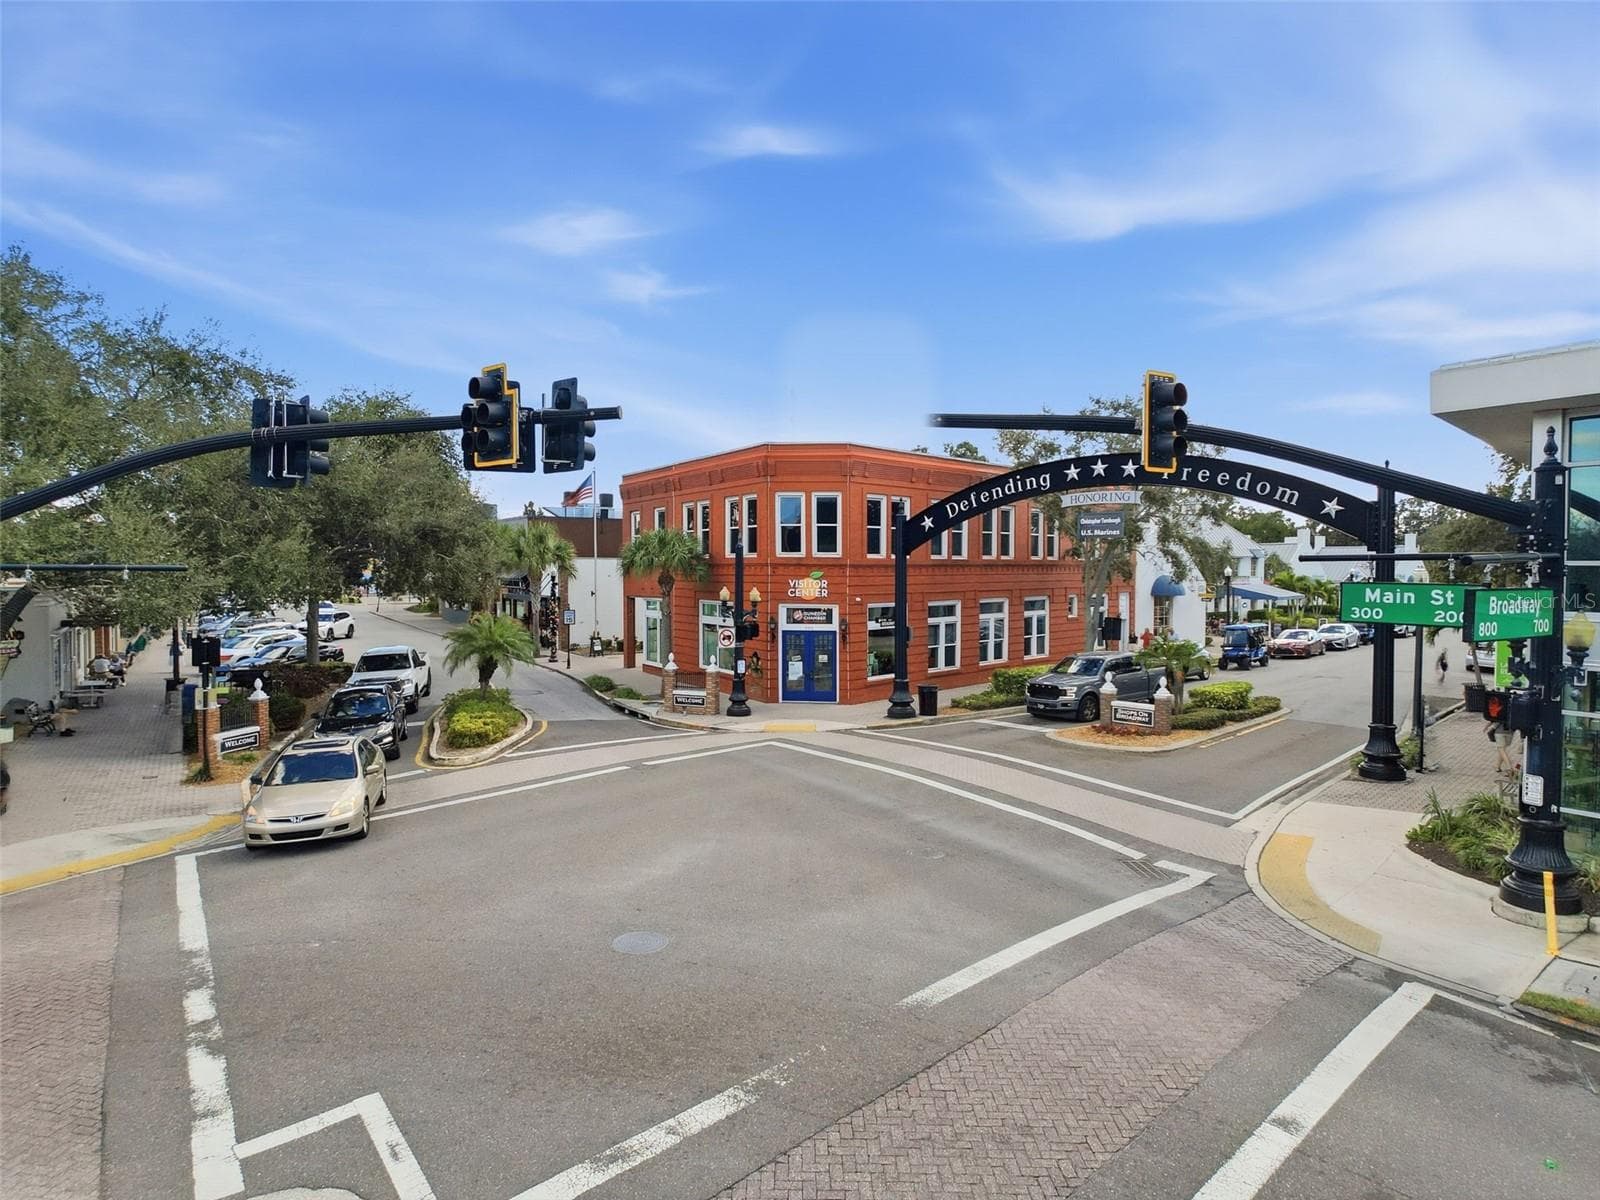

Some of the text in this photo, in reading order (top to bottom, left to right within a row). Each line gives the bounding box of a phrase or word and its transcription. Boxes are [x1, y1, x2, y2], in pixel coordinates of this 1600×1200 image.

[945, 465, 1300, 519] Defending reedom
[1070, 491, 1131, 505] HONORING
[1094, 528, 1121, 536] Marines
[788, 579, 828, 589] VISITOR
[787, 588, 828, 598] CENTER
[1365, 587, 1454, 606] Main St
[1350, 607, 1383, 619] 300
[1489, 596, 1541, 617] Broadway
[1478, 619, 1550, 636] 800 700
[224, 736, 256, 748] WELCOME
